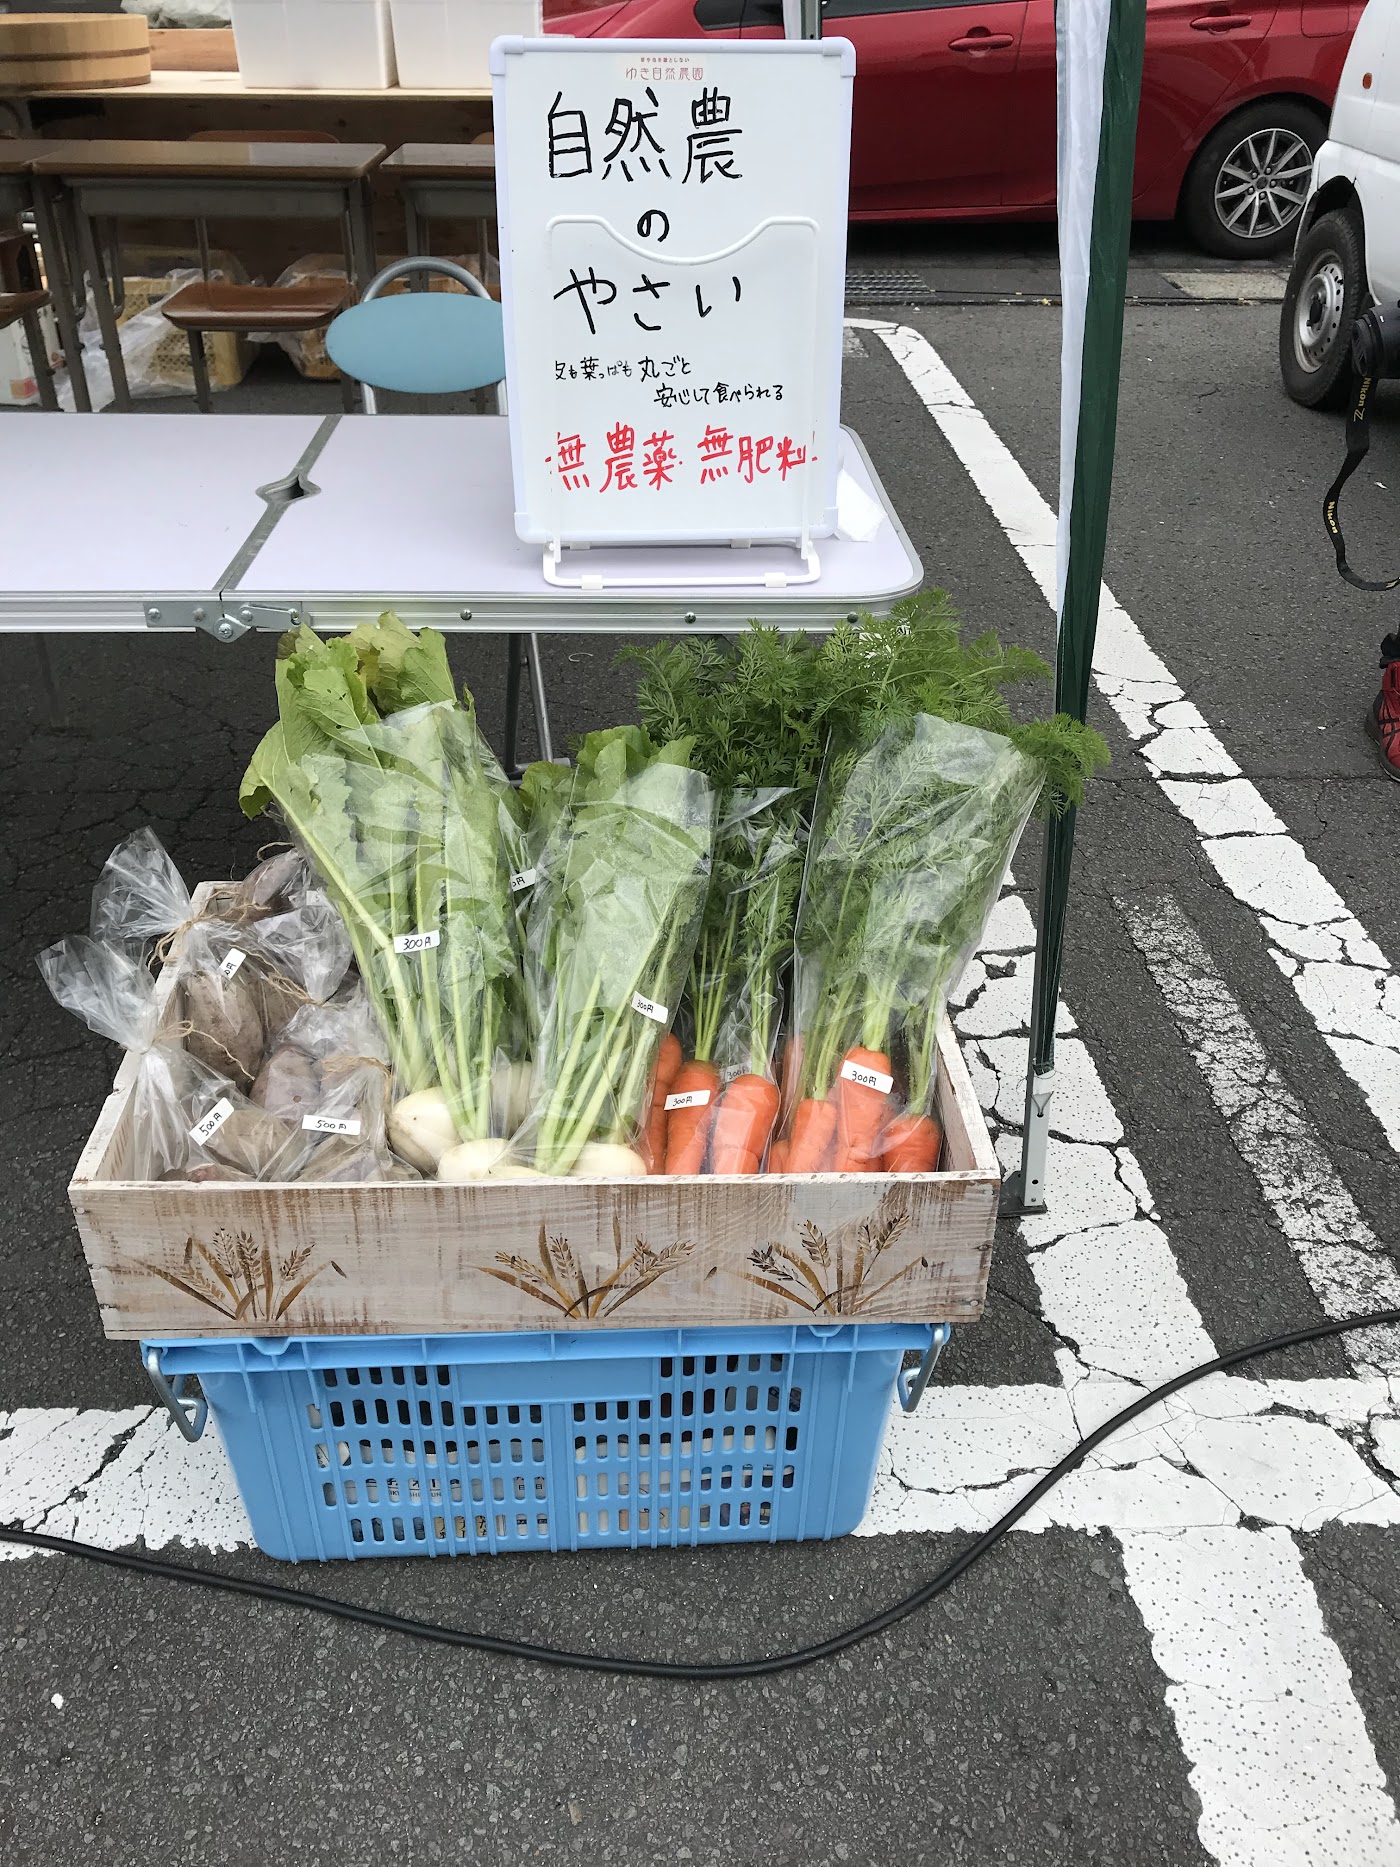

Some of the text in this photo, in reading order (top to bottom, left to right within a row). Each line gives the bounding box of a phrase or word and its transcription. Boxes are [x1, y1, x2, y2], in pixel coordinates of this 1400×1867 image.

[625, 67, 704, 81] ゆき自然農園
[548, 87, 743, 185] 自然農
[637, 209, 670, 243] の
[553, 267, 742, 335] やさい
[653, 382, 784, 408] 安心して食べられる
[1358, 377, 1372, 407] Nikon
[1327, 501, 1338, 534] Nikon
[403, 936, 431, 951] 300円
[636, 999, 654, 1014] 300円
[851, 1070, 877, 1087] 300円
[672, 1095, 693, 1107] 300円
[198, 1112, 223, 1137] 500円
[314, 1119, 347, 1130] 500円
